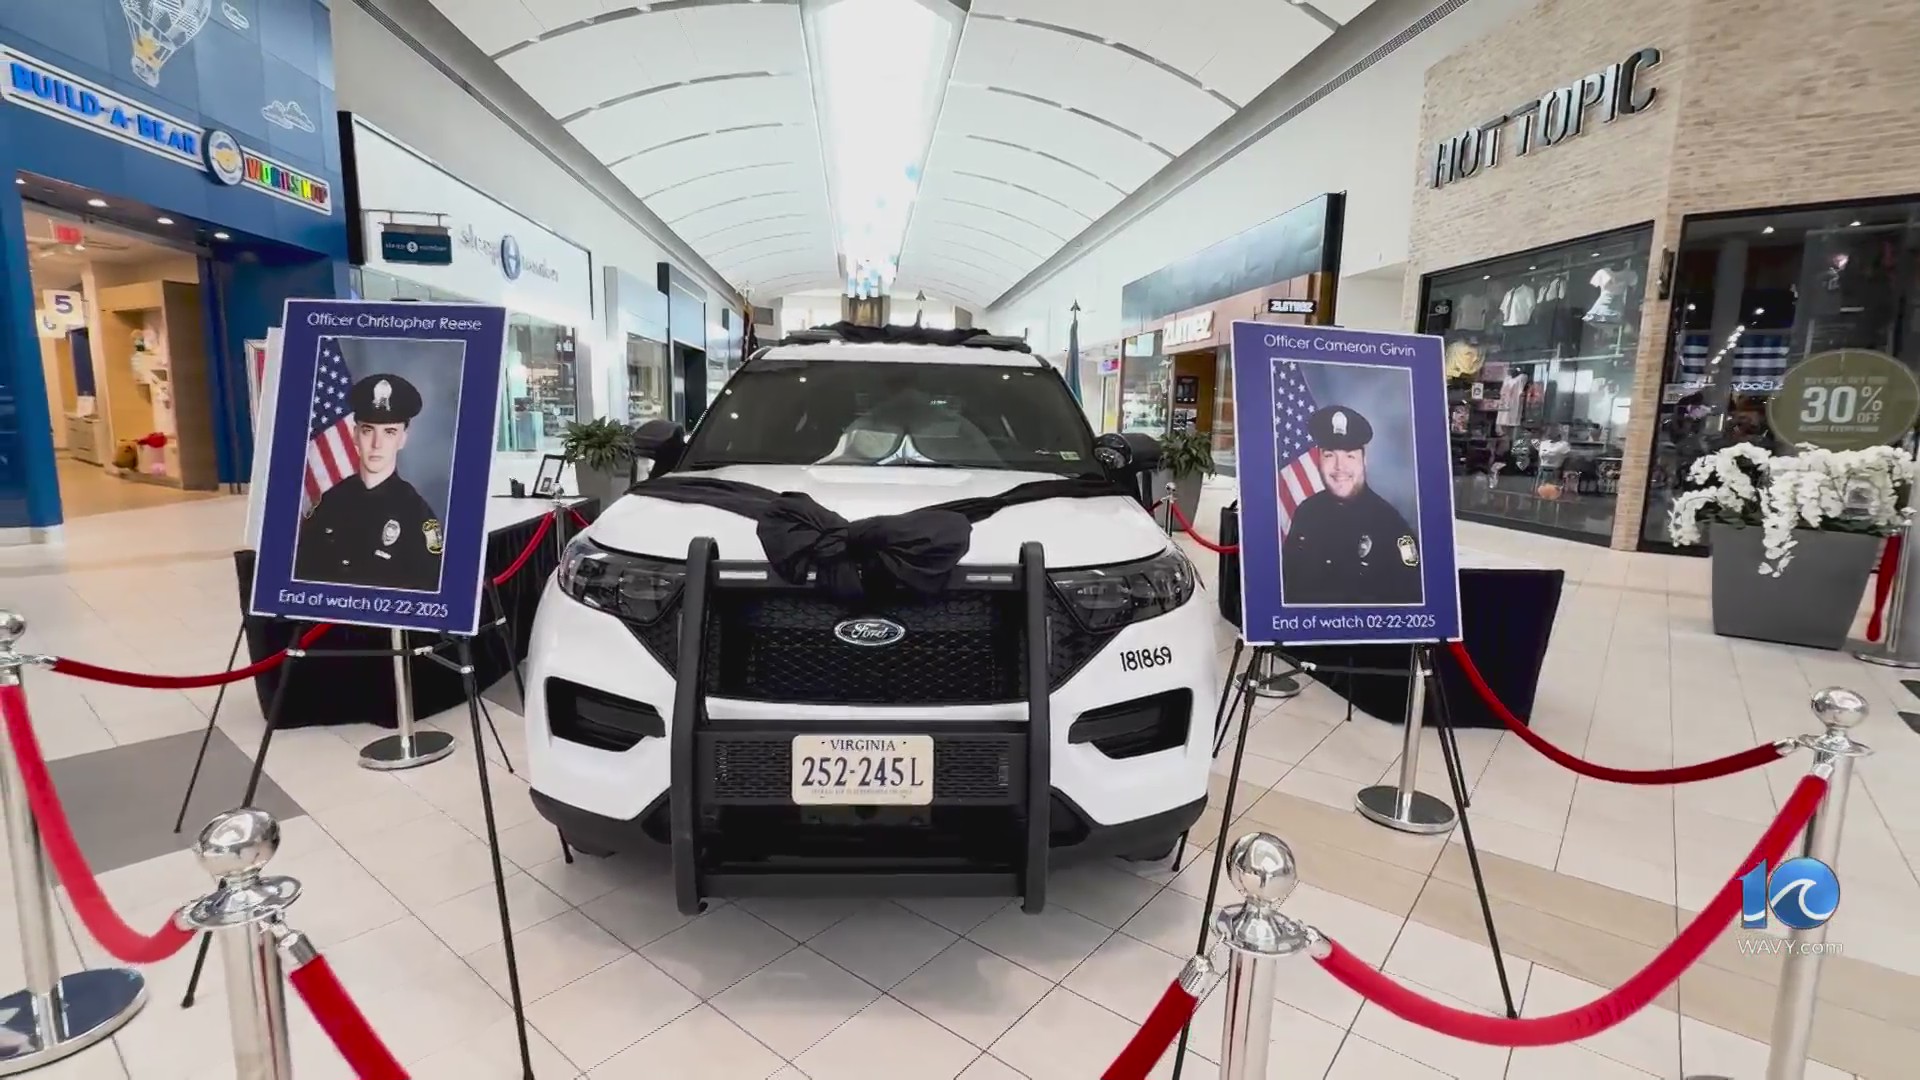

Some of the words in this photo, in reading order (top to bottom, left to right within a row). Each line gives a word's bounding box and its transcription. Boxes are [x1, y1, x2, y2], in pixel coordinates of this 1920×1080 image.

[9, 61, 198, 156] BUILD-A-BEAR
[1428, 113, 1509, 190] HOT
[1508, 47, 1663, 158] TOPIC
[54, 294, 74, 314] 5
[306, 312, 354, 327] Officer
[357, 313, 436, 332] Christopher
[439, 316, 482, 332] Reese
[1263, 333, 1311, 350] Officer
[1313, 337, 1377, 354] Cameron
[1379, 342, 1416, 358] Girvin
[1800, 385, 1884, 424] 30%
[1856, 412, 1882, 424] OFF
[278, 589, 306, 605] End
[308, 593, 324, 606] of
[326, 595, 371, 611] watch
[373, 597, 449, 619] 02-22-2025
[851, 623, 889, 639] Ford
[1271, 615, 1299, 631] End
[1302, 615, 1317, 630] of
[1319, 615, 1364, 630] watch
[1366, 614, 1436, 629] 02-22-2025
[1119, 646, 1172, 672] 181869
[829, 739, 897, 752] VIRGINIA
